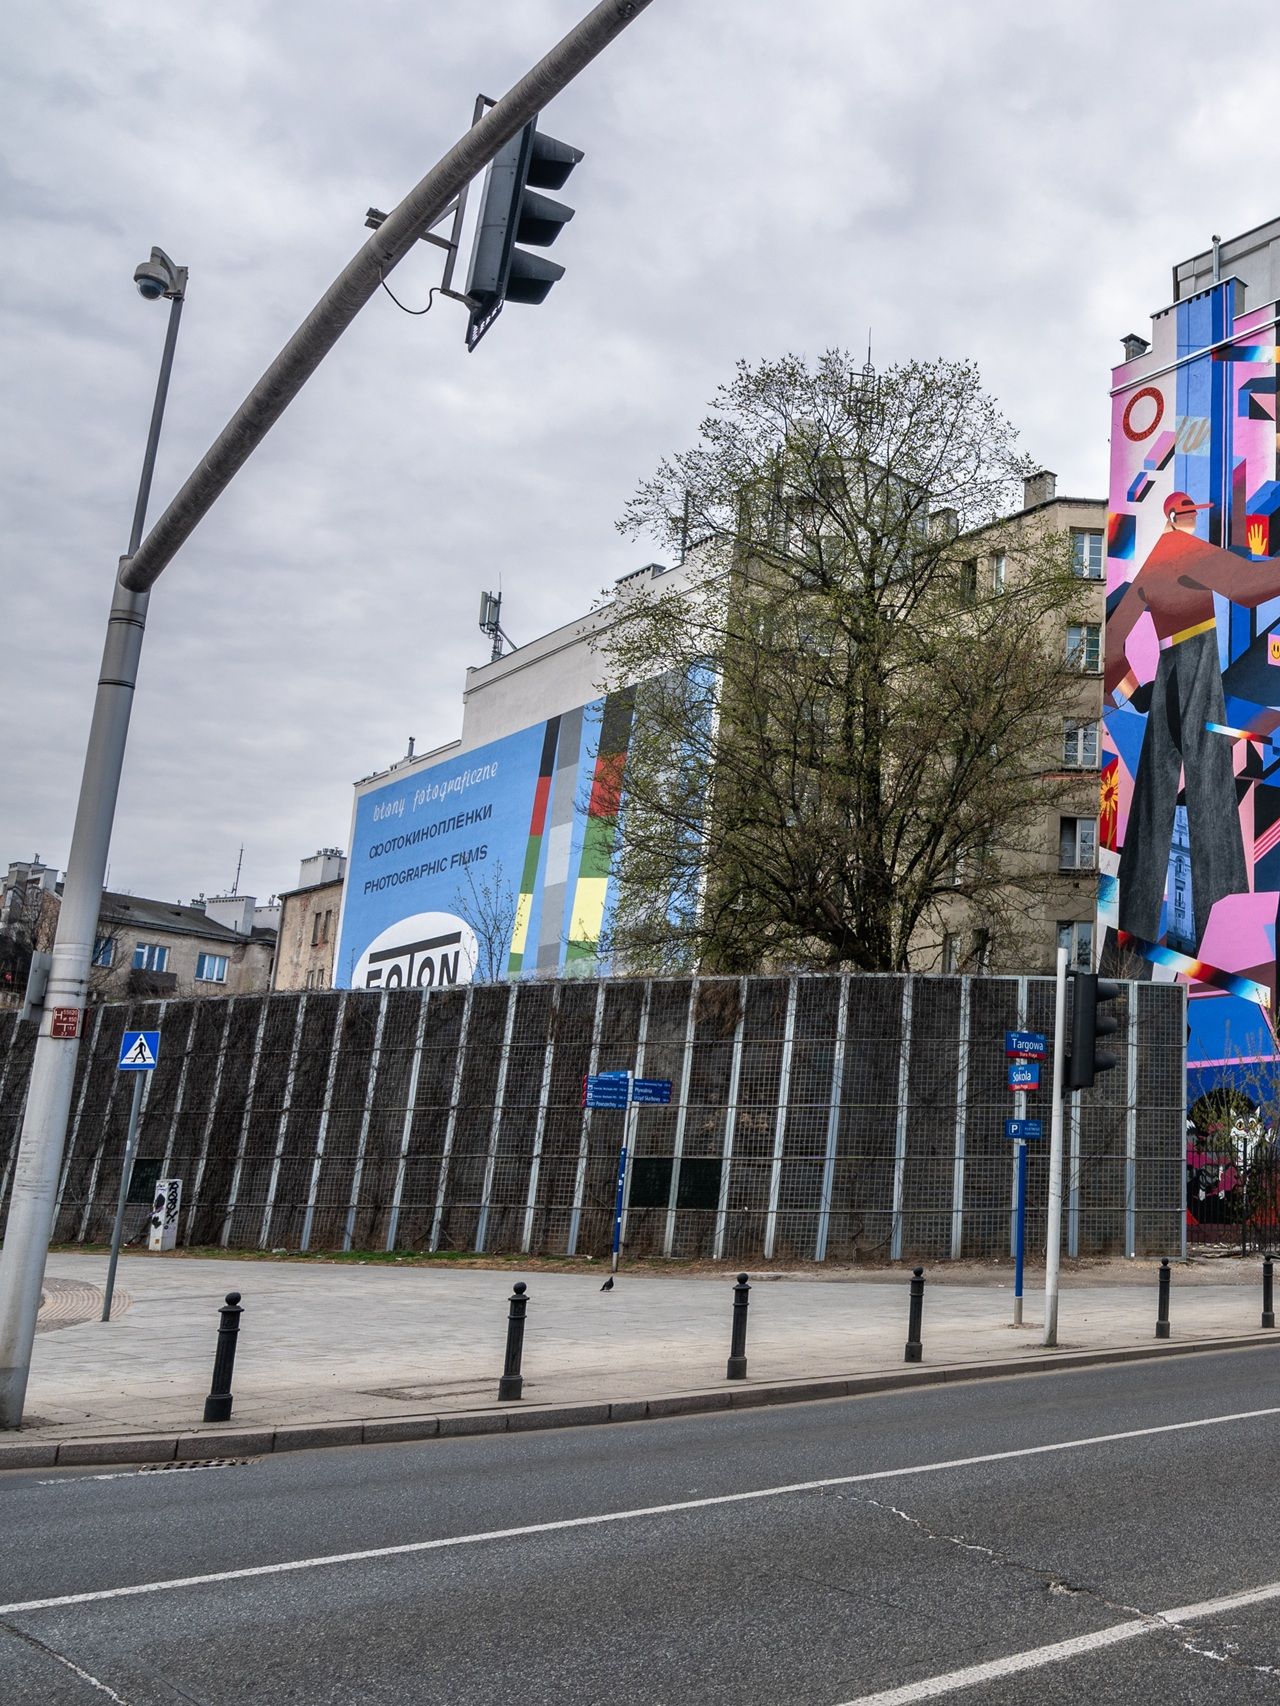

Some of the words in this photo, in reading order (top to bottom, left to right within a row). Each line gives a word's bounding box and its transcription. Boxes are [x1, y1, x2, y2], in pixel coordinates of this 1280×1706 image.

[413, 761, 499, 813] fotograficzne
[363, 857, 448, 895] PHOTOGRAPHIC
[450, 844, 488, 869] FILMS
[1012, 1038, 1044, 1052] Targowa
